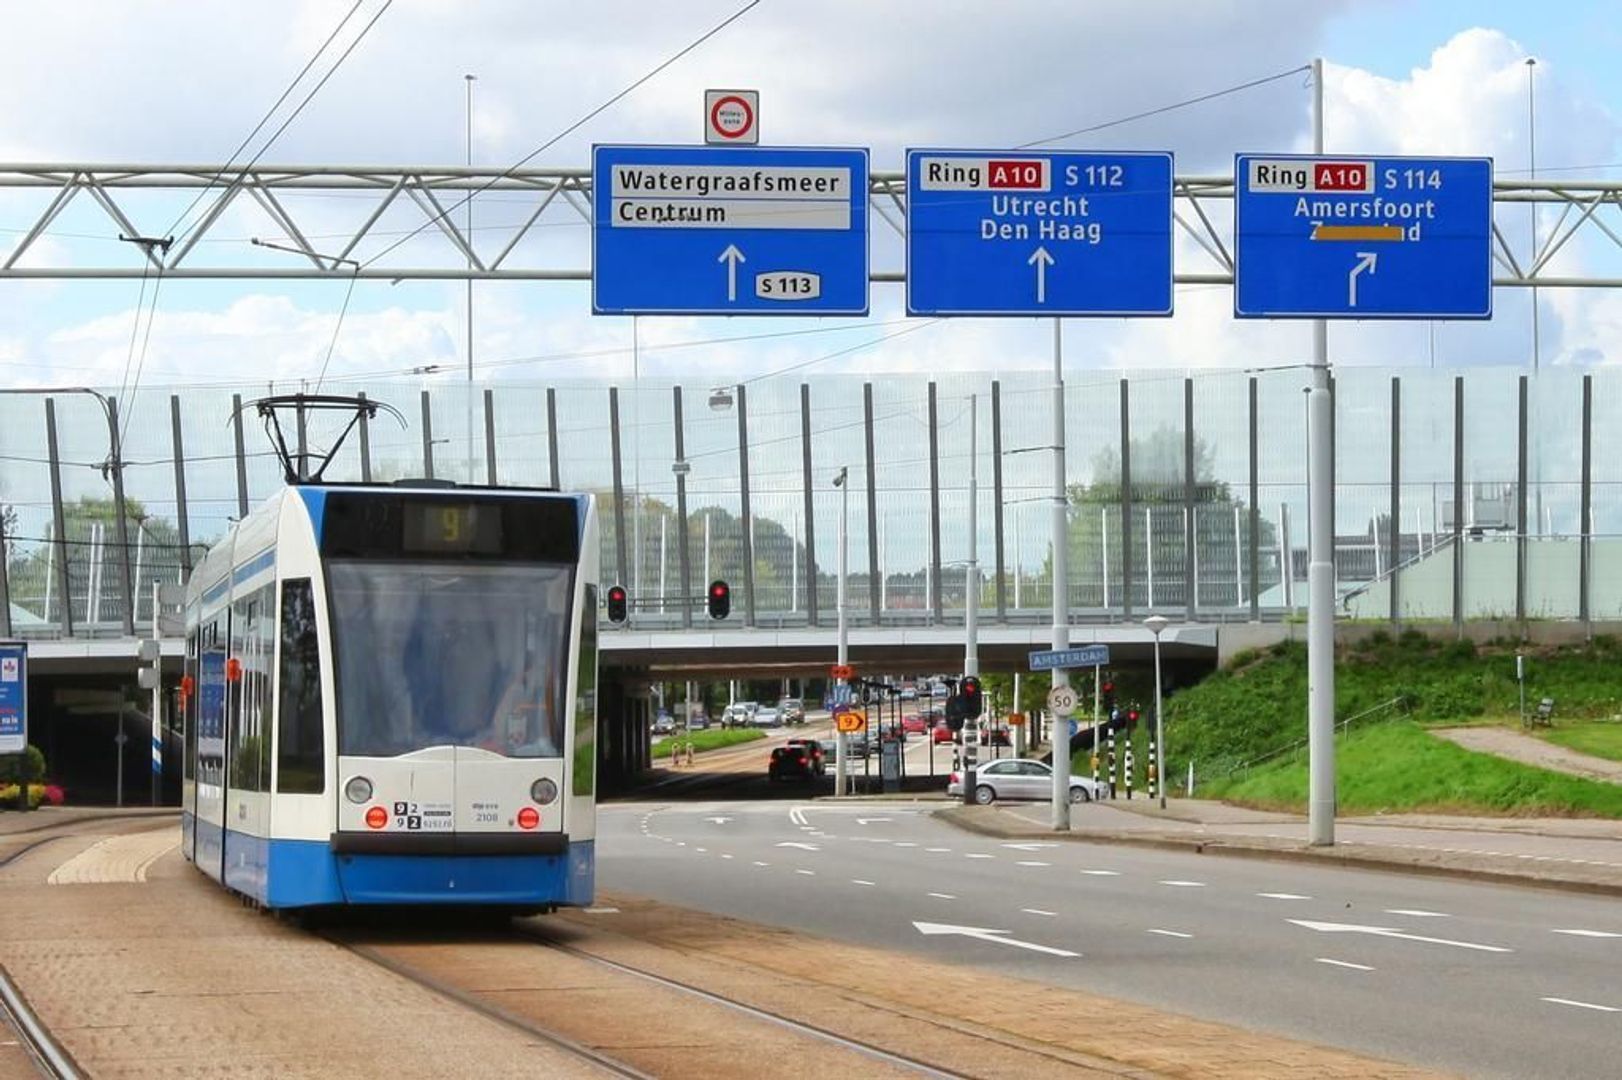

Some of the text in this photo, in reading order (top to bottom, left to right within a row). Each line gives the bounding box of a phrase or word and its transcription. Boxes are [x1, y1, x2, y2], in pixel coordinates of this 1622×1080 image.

[619, 170, 840, 196] Watergraafsmeer
[928, 163, 1037, 187] Ring A10
[1065, 165, 1123, 187] S 112
[1256, 165, 1361, 189] Ring A10
[1384, 169, 1441, 190] S 114
[619, 201, 726, 223] Centrum
[992, 195, 1088, 217] Utrecht
[1294, 197, 1435, 219] Amersfoort
[981, 219, 1101, 244] Den Haag
[762, 278, 811, 293] S 113
[443, 507, 459, 541] 9
[1054, 695, 1072, 708] 50
[396, 802, 405, 814] 9
[410, 803, 418, 814] 2
[397, 817, 404, 828] 9
[410, 816, 418, 828] 2
